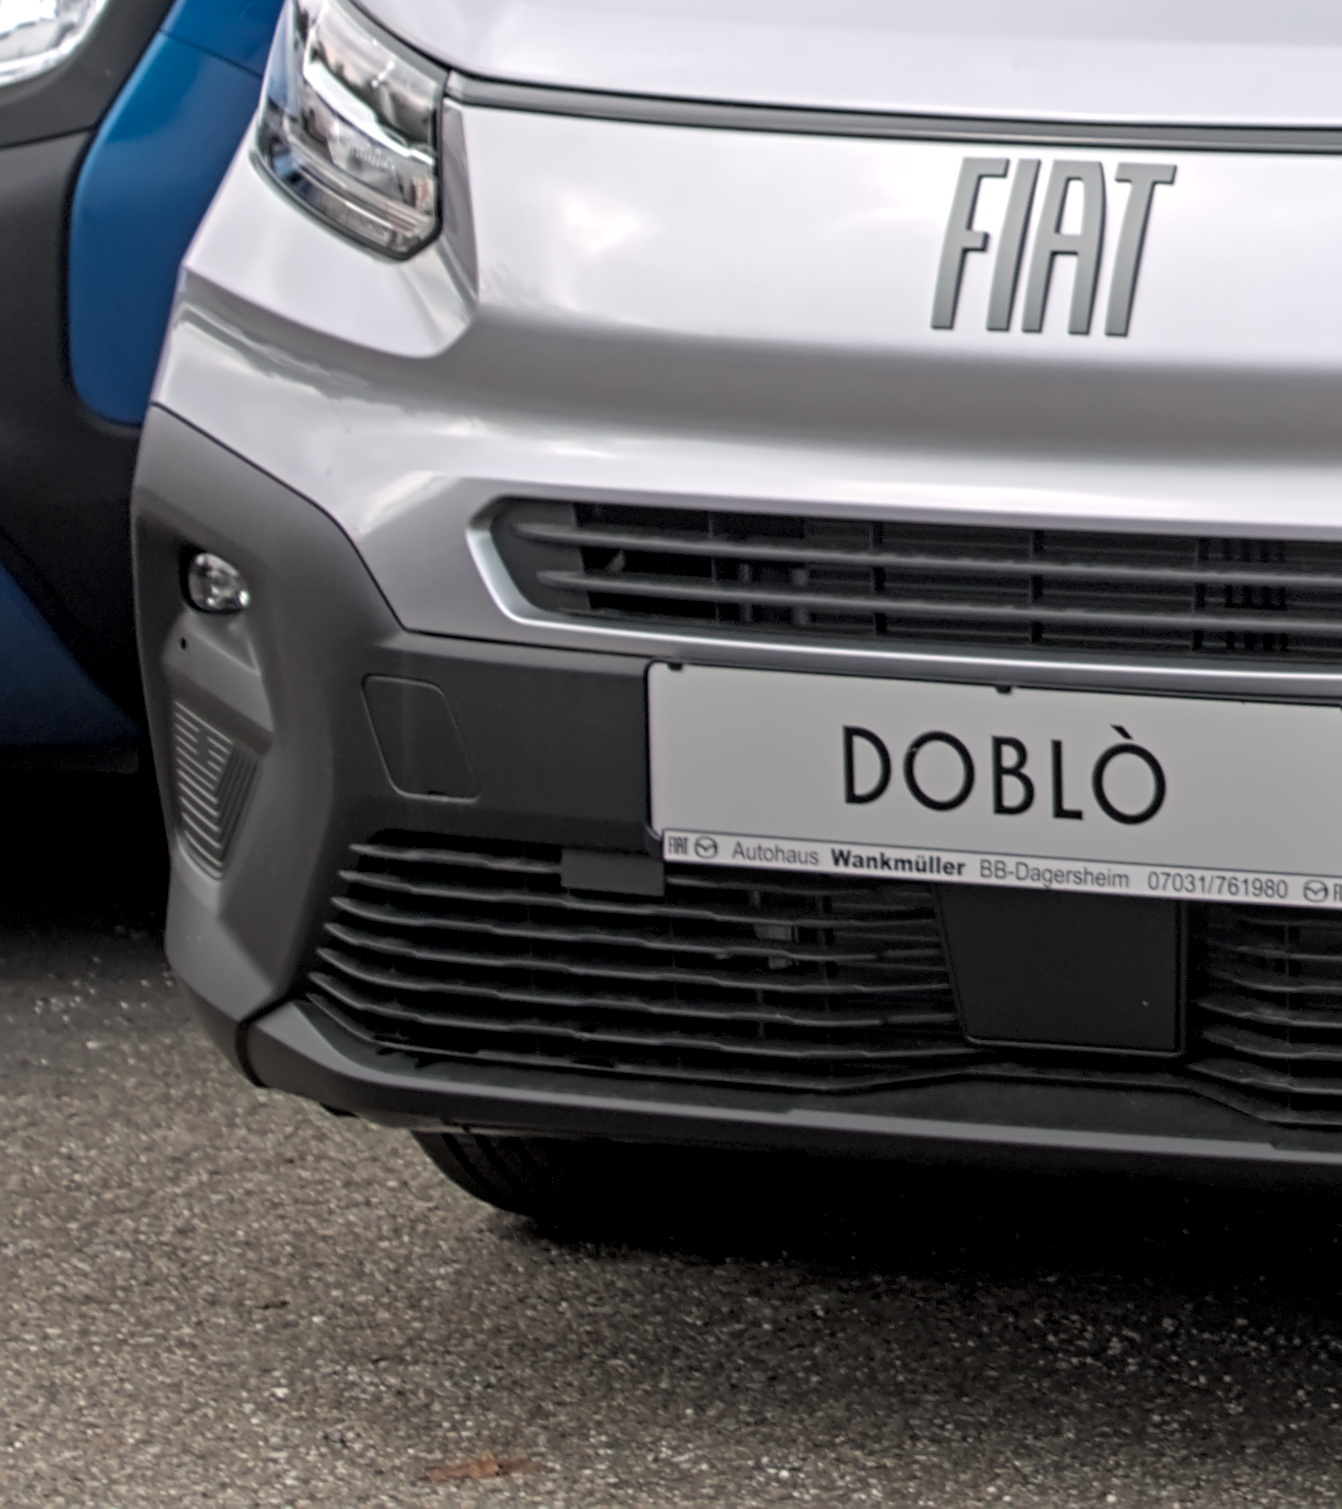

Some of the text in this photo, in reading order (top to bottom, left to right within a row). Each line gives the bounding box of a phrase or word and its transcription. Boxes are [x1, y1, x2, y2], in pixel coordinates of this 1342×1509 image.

[931, 157, 1178, 337] FIAT
[842, 724, 1166, 825] DOBLÒ
[667, 836, 688, 857] FIAT
[731, 841, 819, 866] Autohaus
[830, 848, 966, 877] Wankmüller
[980, 858, 1130, 890] BB-Dagersheim
[1147, 871, 1289, 900] 07031/761980
